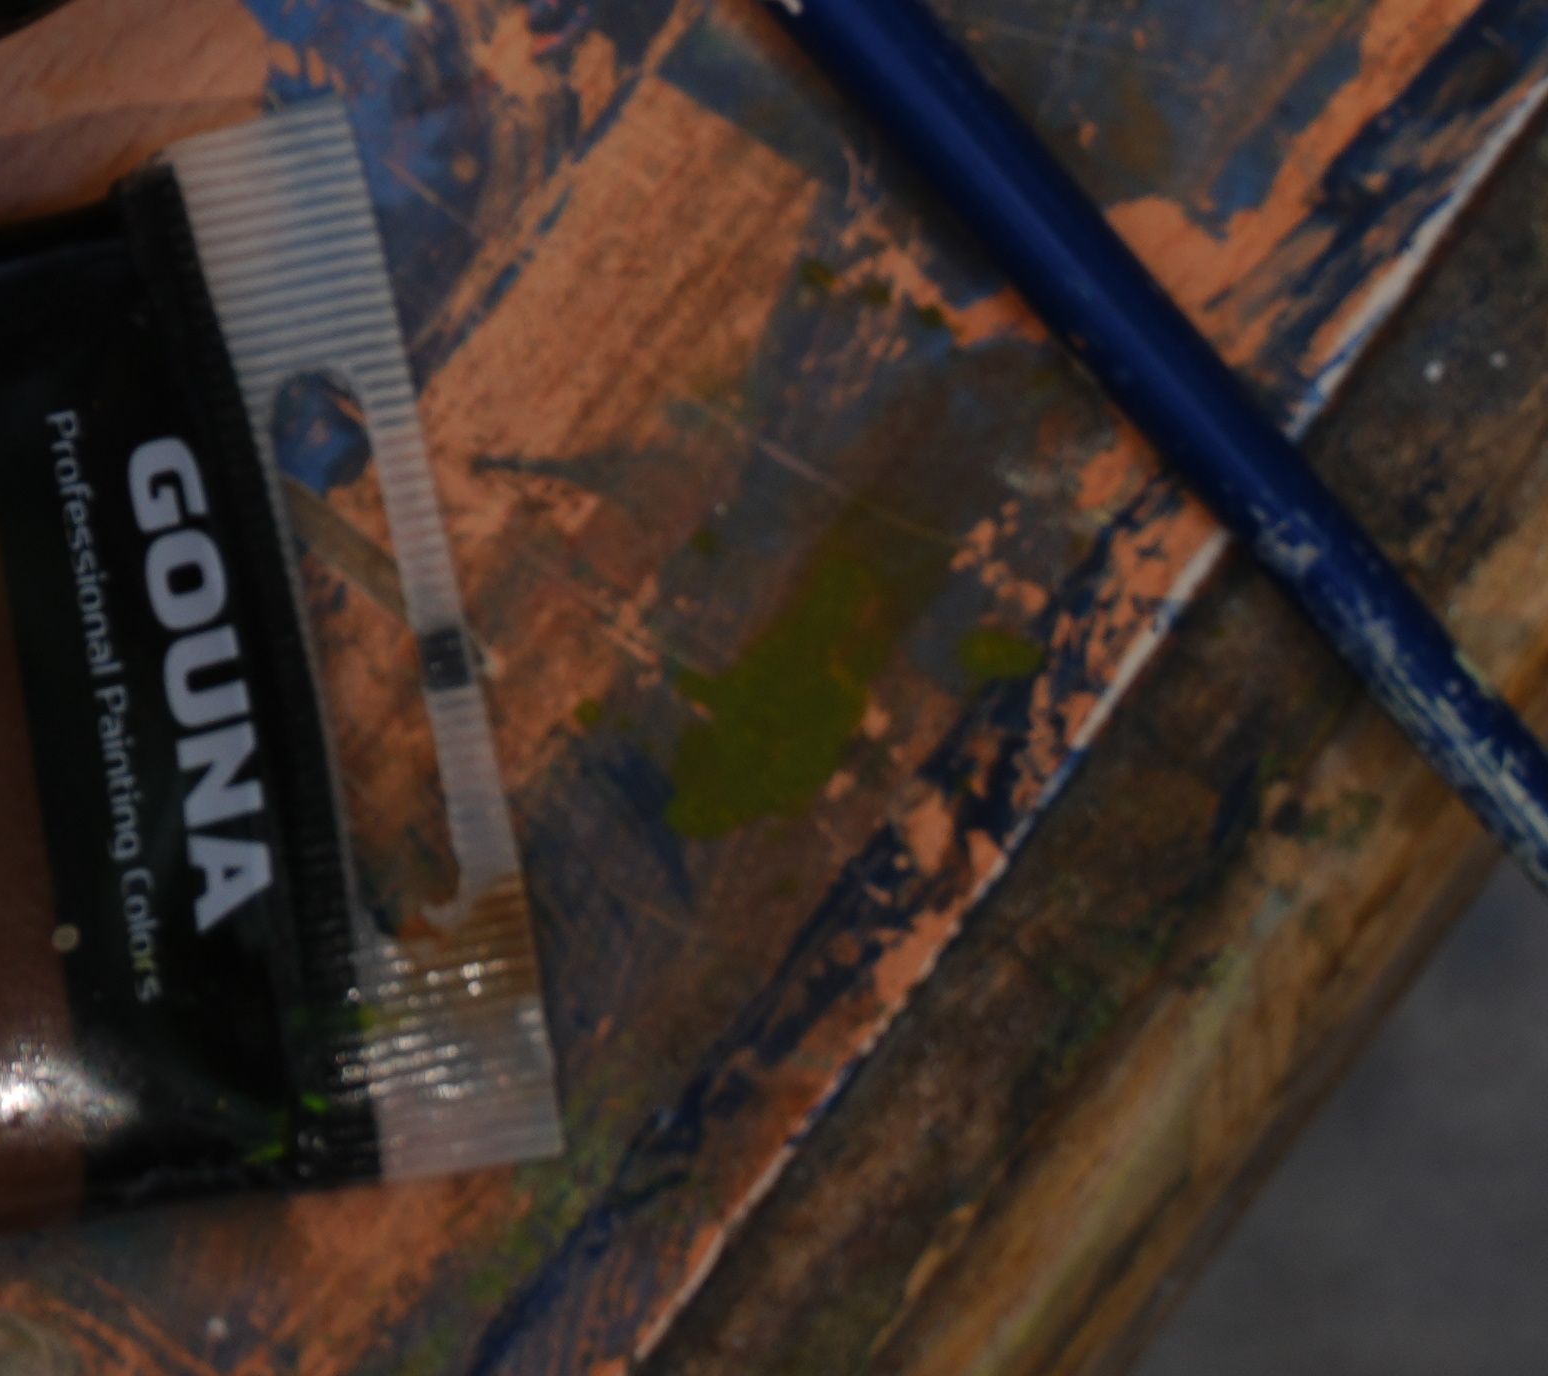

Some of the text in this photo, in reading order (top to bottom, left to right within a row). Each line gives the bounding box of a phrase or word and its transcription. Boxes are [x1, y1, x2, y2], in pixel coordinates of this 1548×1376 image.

[44, 408, 164, 1005] Professional Painting Colors
[127, 435, 273, 934] GOUNA
